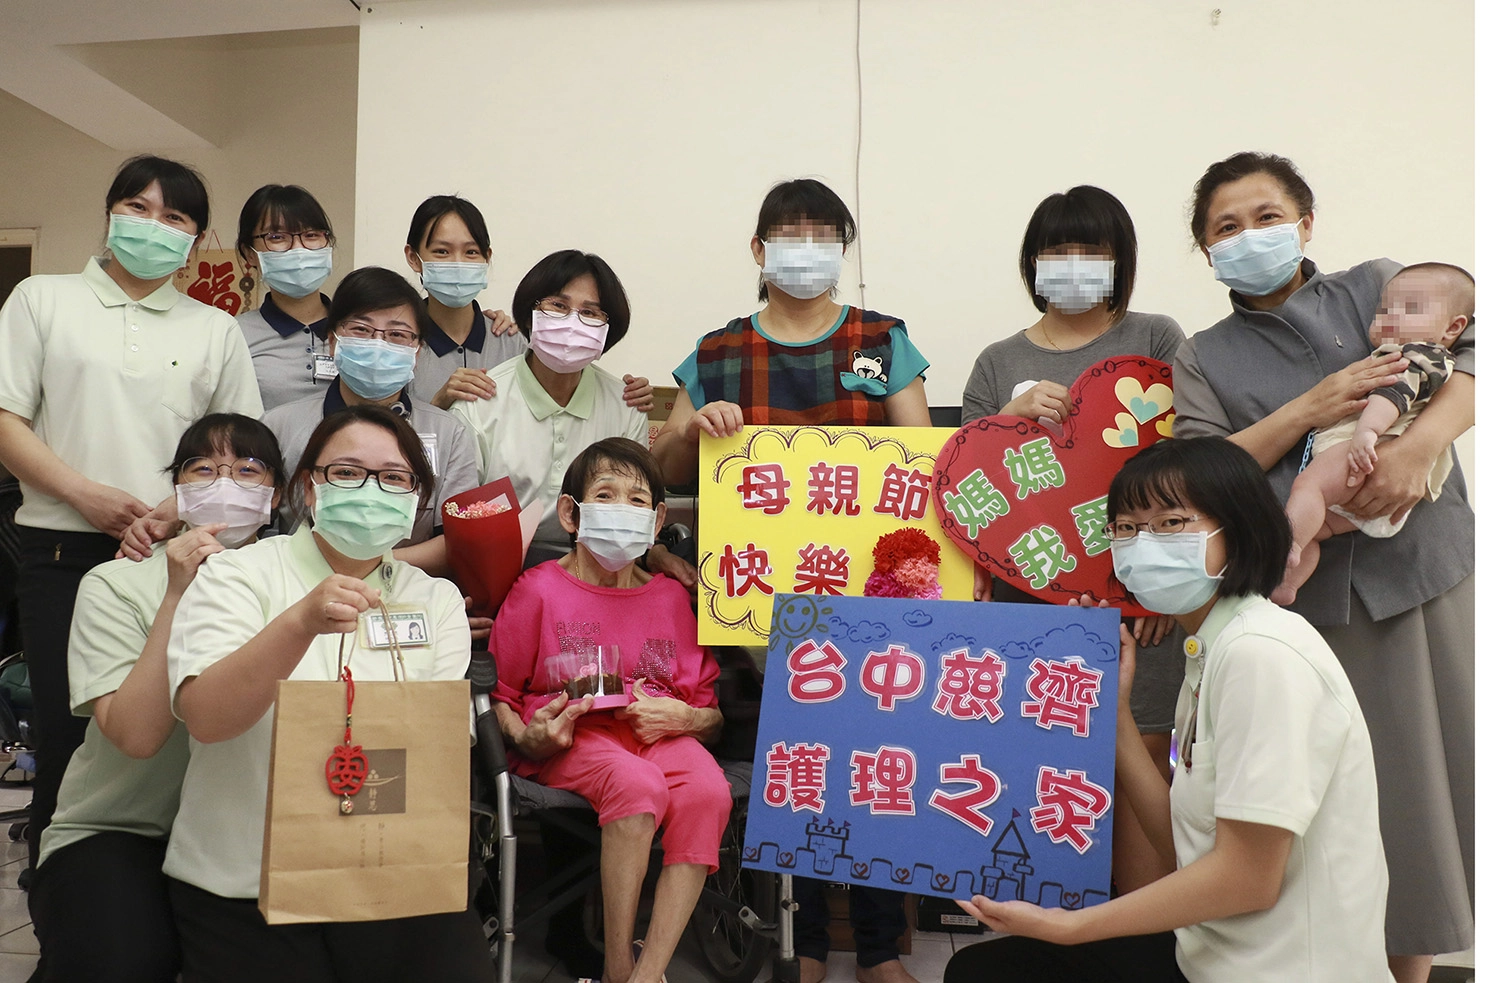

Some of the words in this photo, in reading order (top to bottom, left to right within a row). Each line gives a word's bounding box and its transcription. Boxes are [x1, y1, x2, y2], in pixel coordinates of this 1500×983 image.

[736, 461, 933, 521] 母親節
[943, 437, 1066, 540] 媽媽
[718, 542, 850, 597] 快樂
[786, 638, 1103, 738] 台中慈濟
[762, 741, 1112, 855] 護理之家
